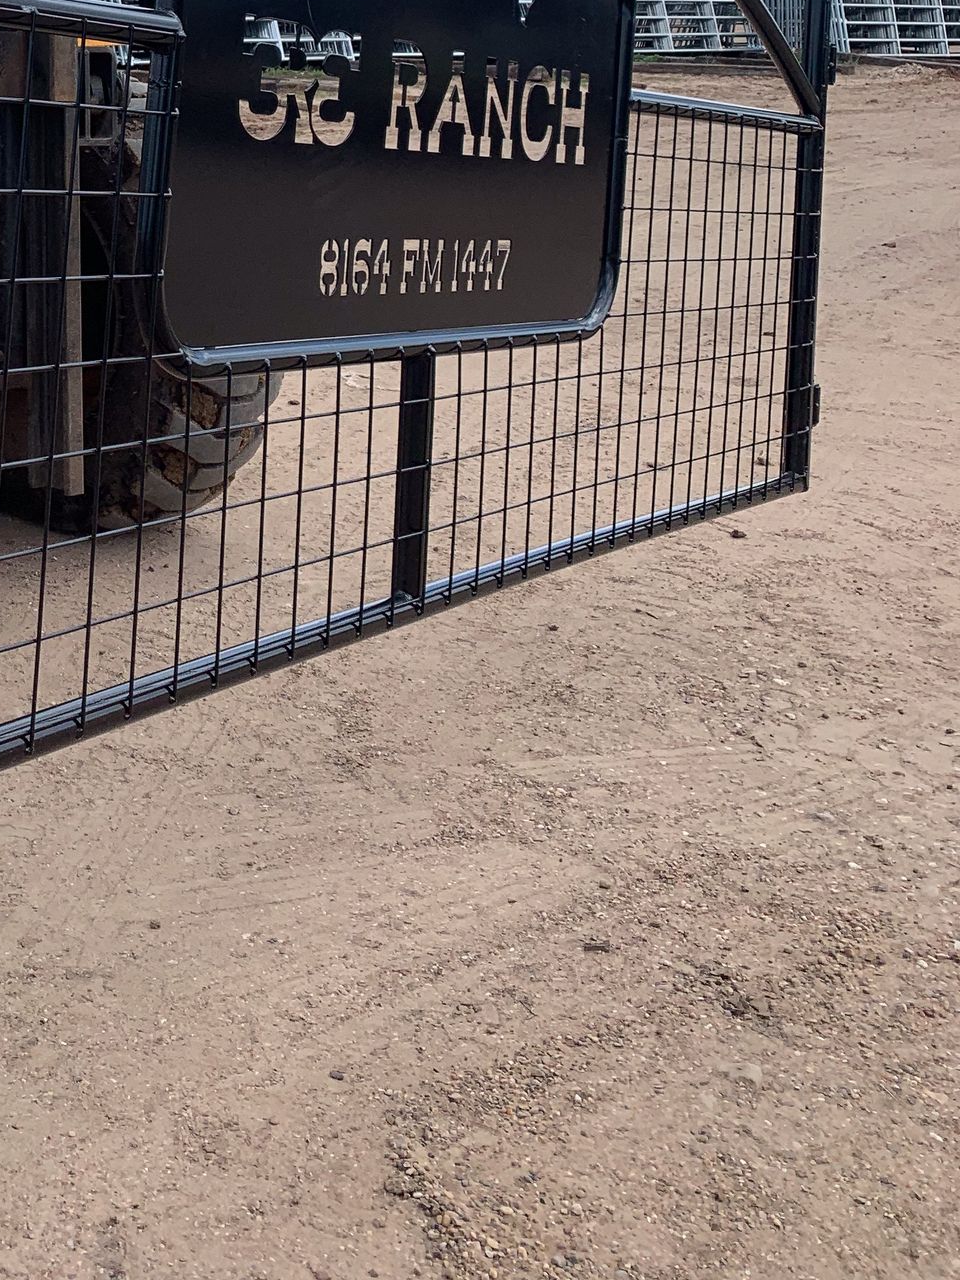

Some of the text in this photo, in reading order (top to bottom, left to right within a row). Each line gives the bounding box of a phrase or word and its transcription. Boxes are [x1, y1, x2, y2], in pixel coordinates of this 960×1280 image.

[384, 38, 590, 165] RANCH
[319, 238, 511, 297] 8164 FM 1447
